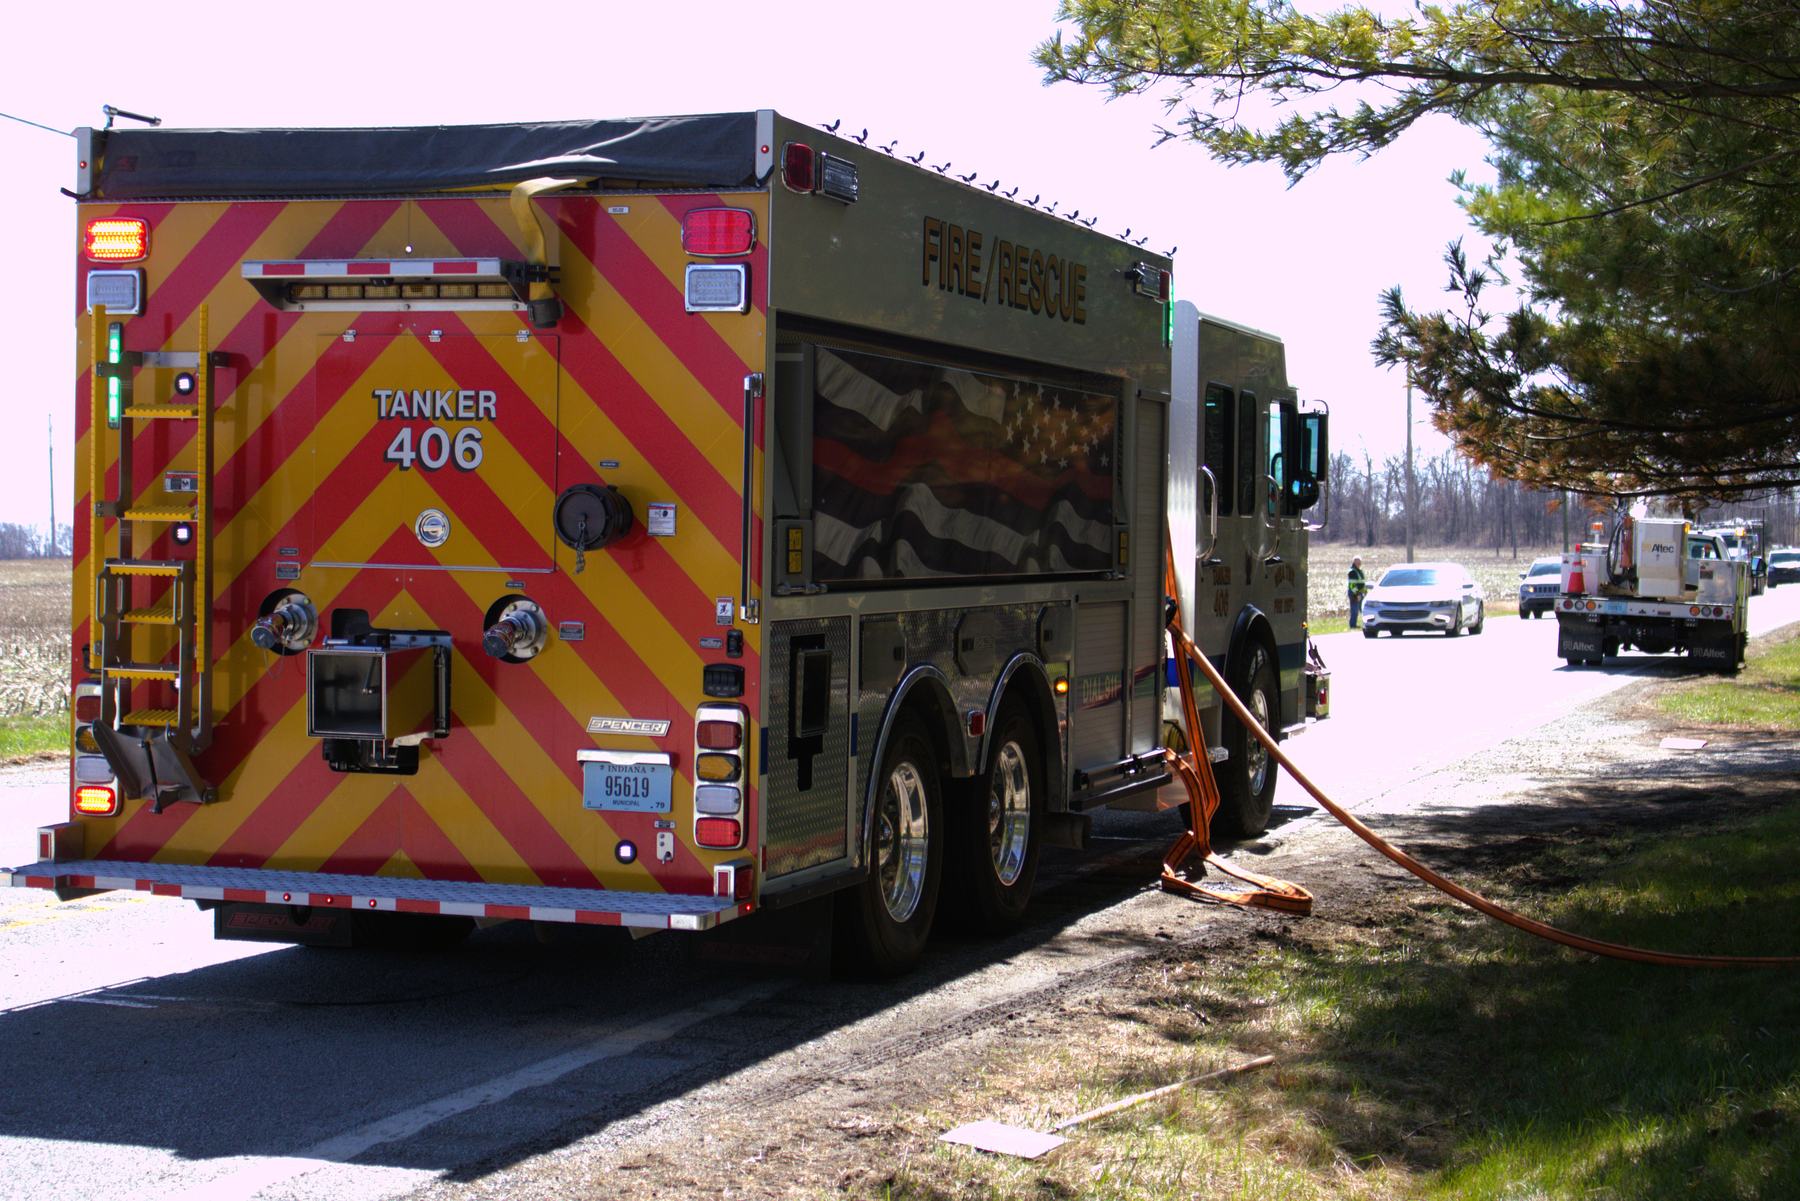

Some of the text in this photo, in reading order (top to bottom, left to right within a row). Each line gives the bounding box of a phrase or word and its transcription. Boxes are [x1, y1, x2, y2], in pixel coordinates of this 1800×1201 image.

[922, 216, 1087, 325] FIRE/RESCUE
[372, 388, 497, 420] TANKER
[384, 426, 483, 472] 406
[1651, 543, 1674, 553] Altec
[1572, 640, 1595, 652] Altec
[1703, 647, 1726, 659] Altec
[590, 719, 664, 733] SPENCER
[607, 764, 647, 774] INDIANA
[605, 775, 650, 798] 95619
